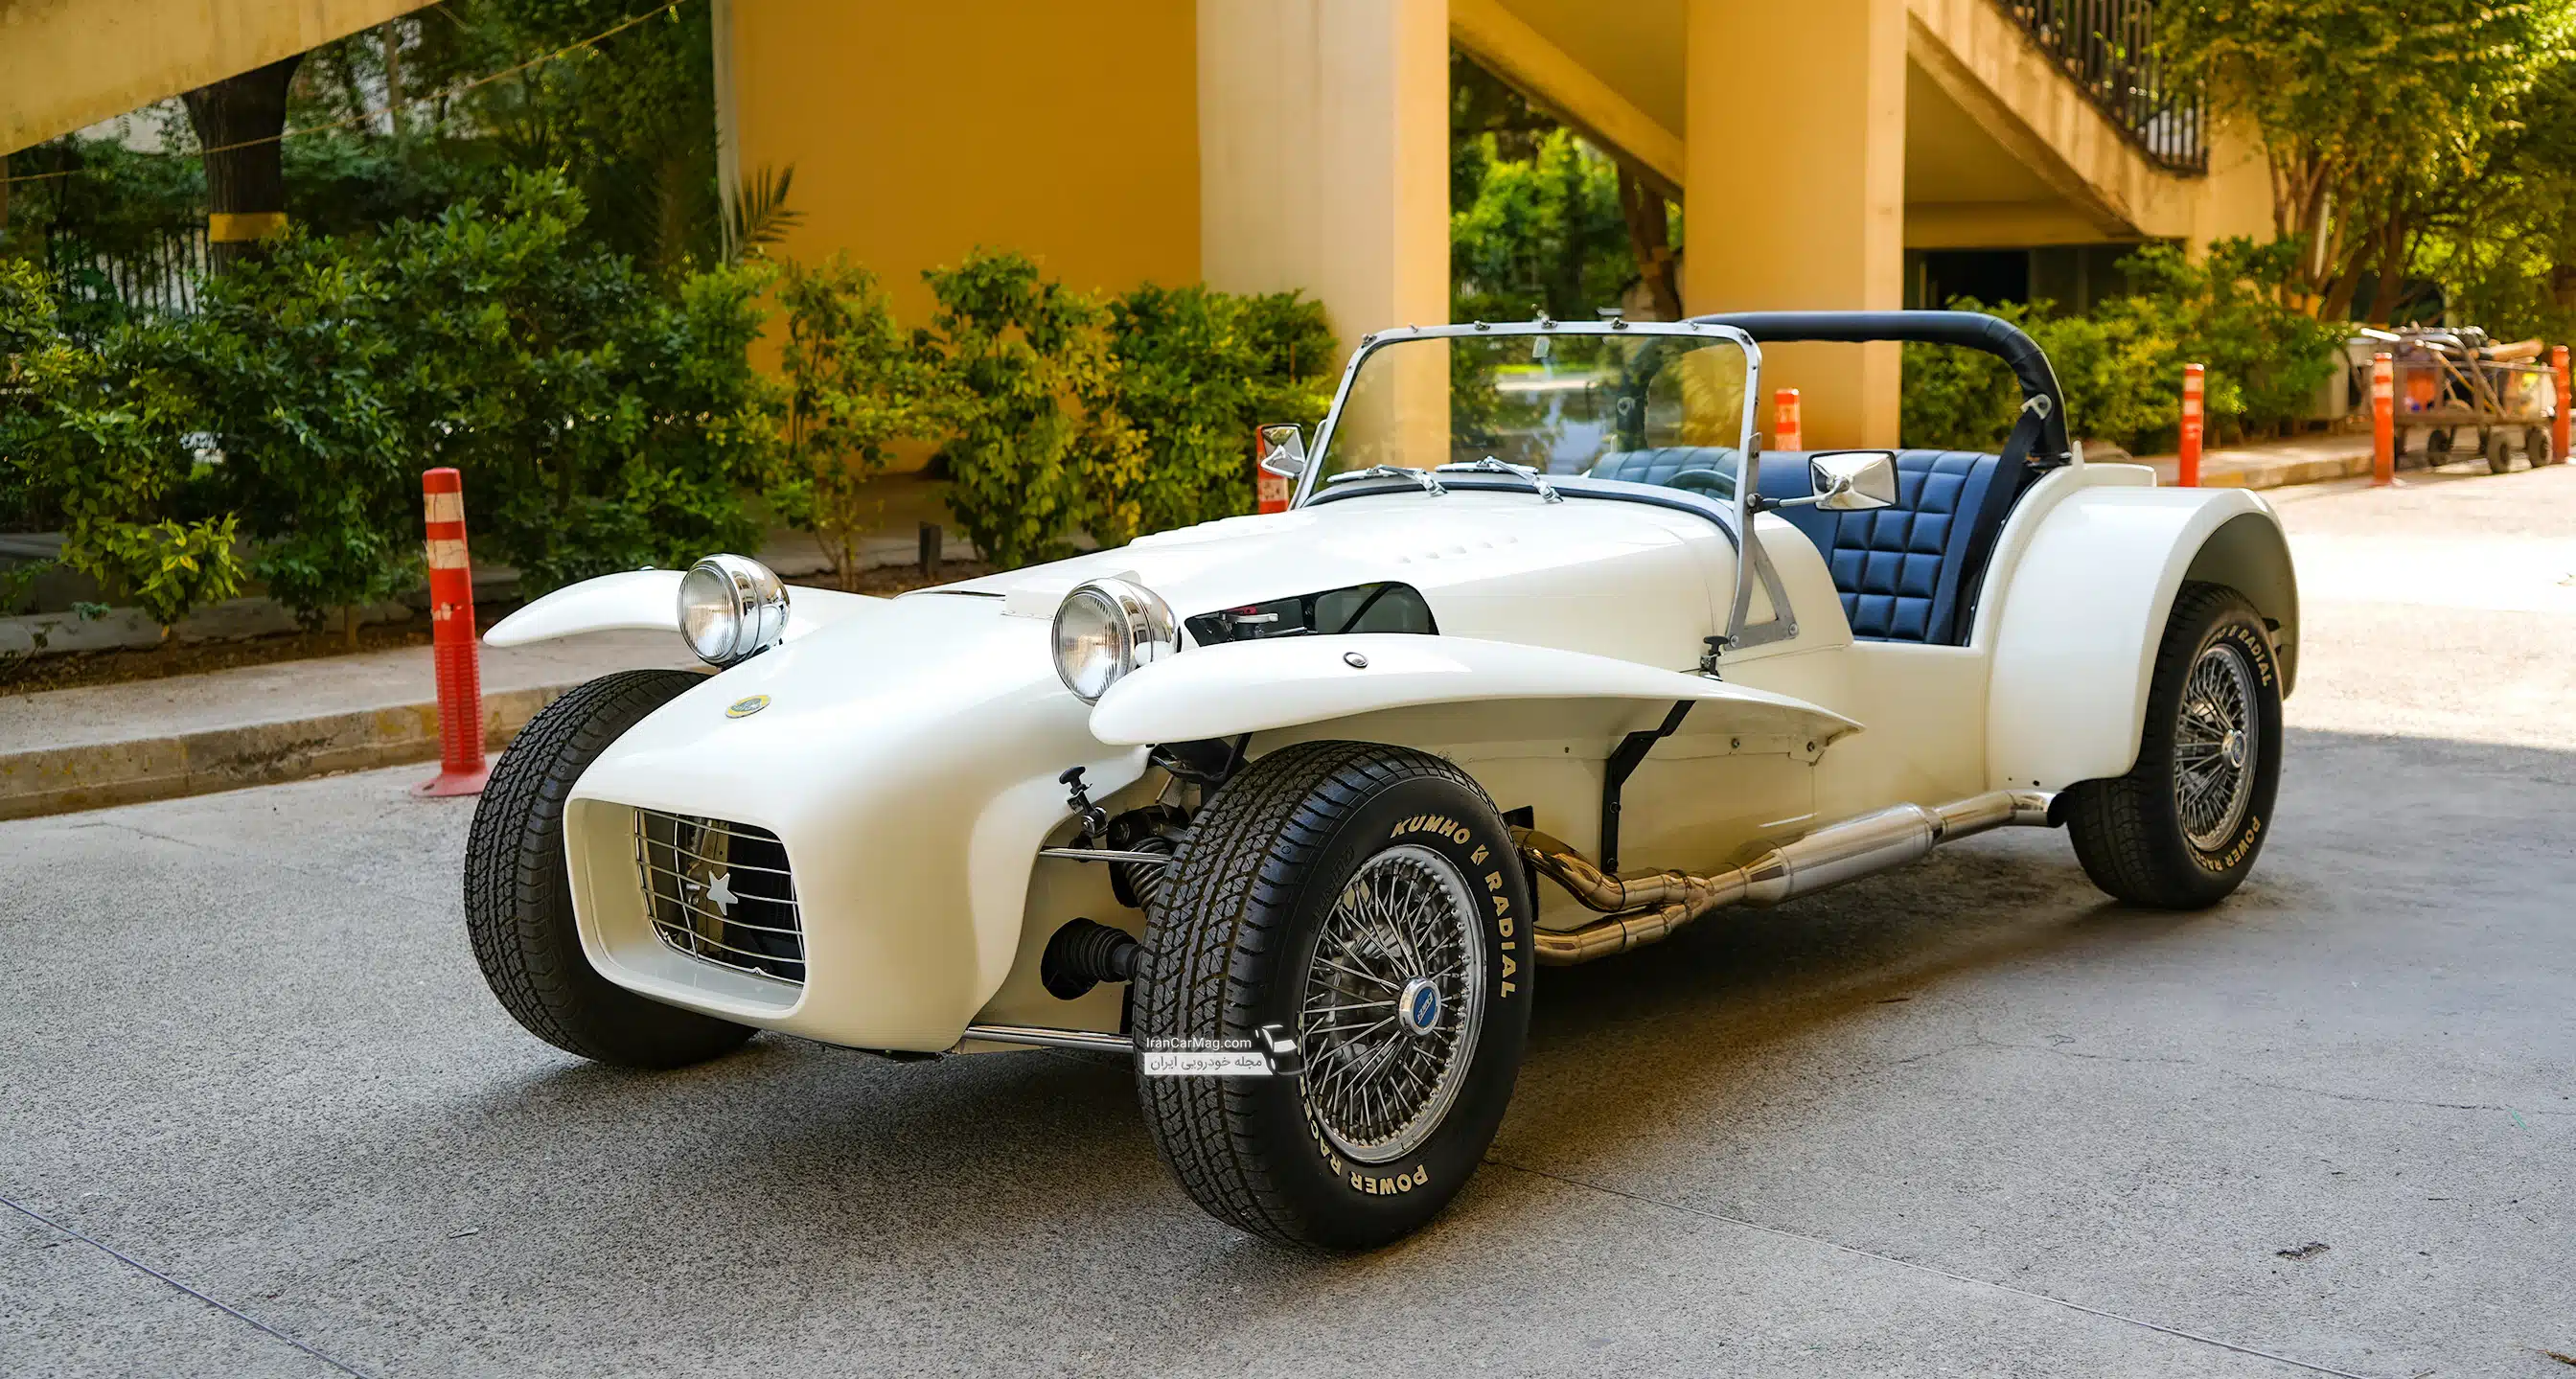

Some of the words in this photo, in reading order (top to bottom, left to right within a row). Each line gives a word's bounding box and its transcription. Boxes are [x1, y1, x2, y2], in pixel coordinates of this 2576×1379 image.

[2238, 628, 2272, 687] RADIAL
[2224, 815, 2261, 868] POWER
[1391, 814, 1471, 845] KUMHO
[1484, 870, 1517, 999] RADIAL
[1349, 1163, 1429, 1195] POWER
